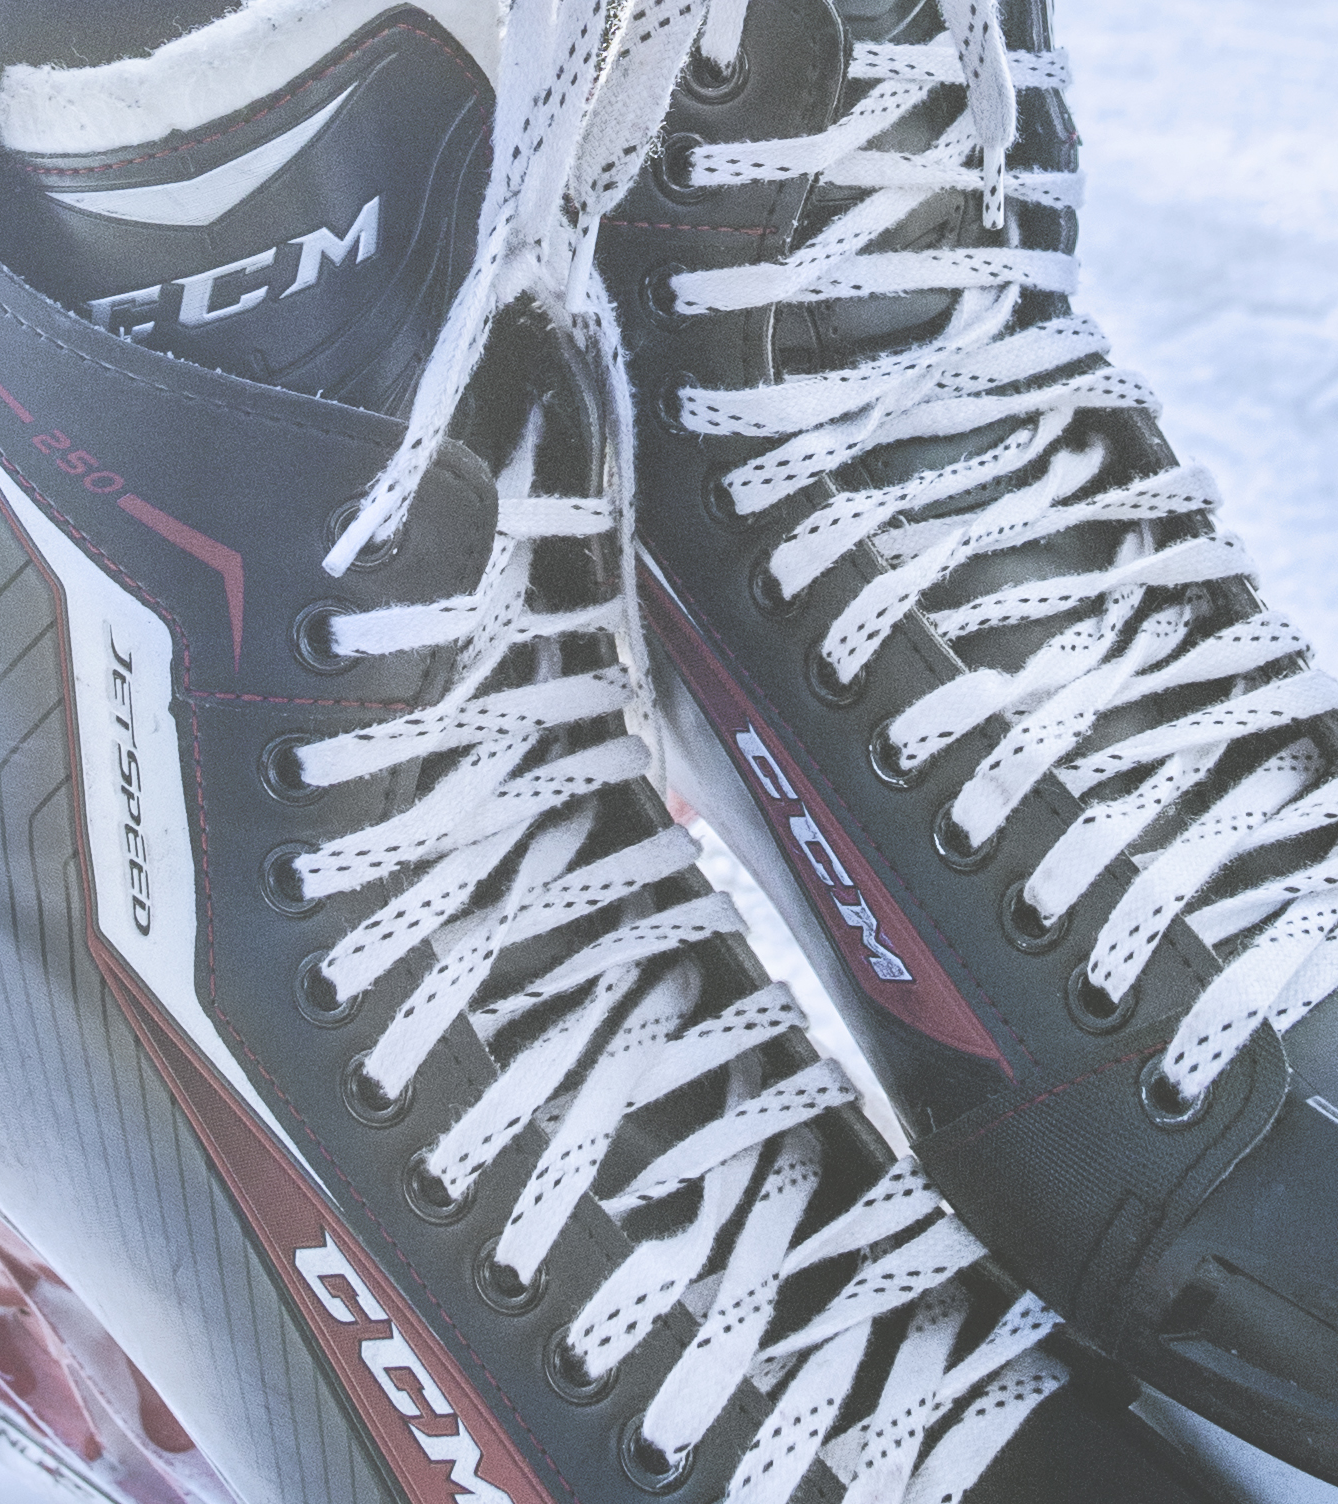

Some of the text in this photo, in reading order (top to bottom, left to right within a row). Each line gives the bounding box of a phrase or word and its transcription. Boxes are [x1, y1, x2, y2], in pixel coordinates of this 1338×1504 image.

[32, 429, 125, 493] 250
[110, 624, 151, 936] JETSPEED
[736, 722, 914, 981] CCM
